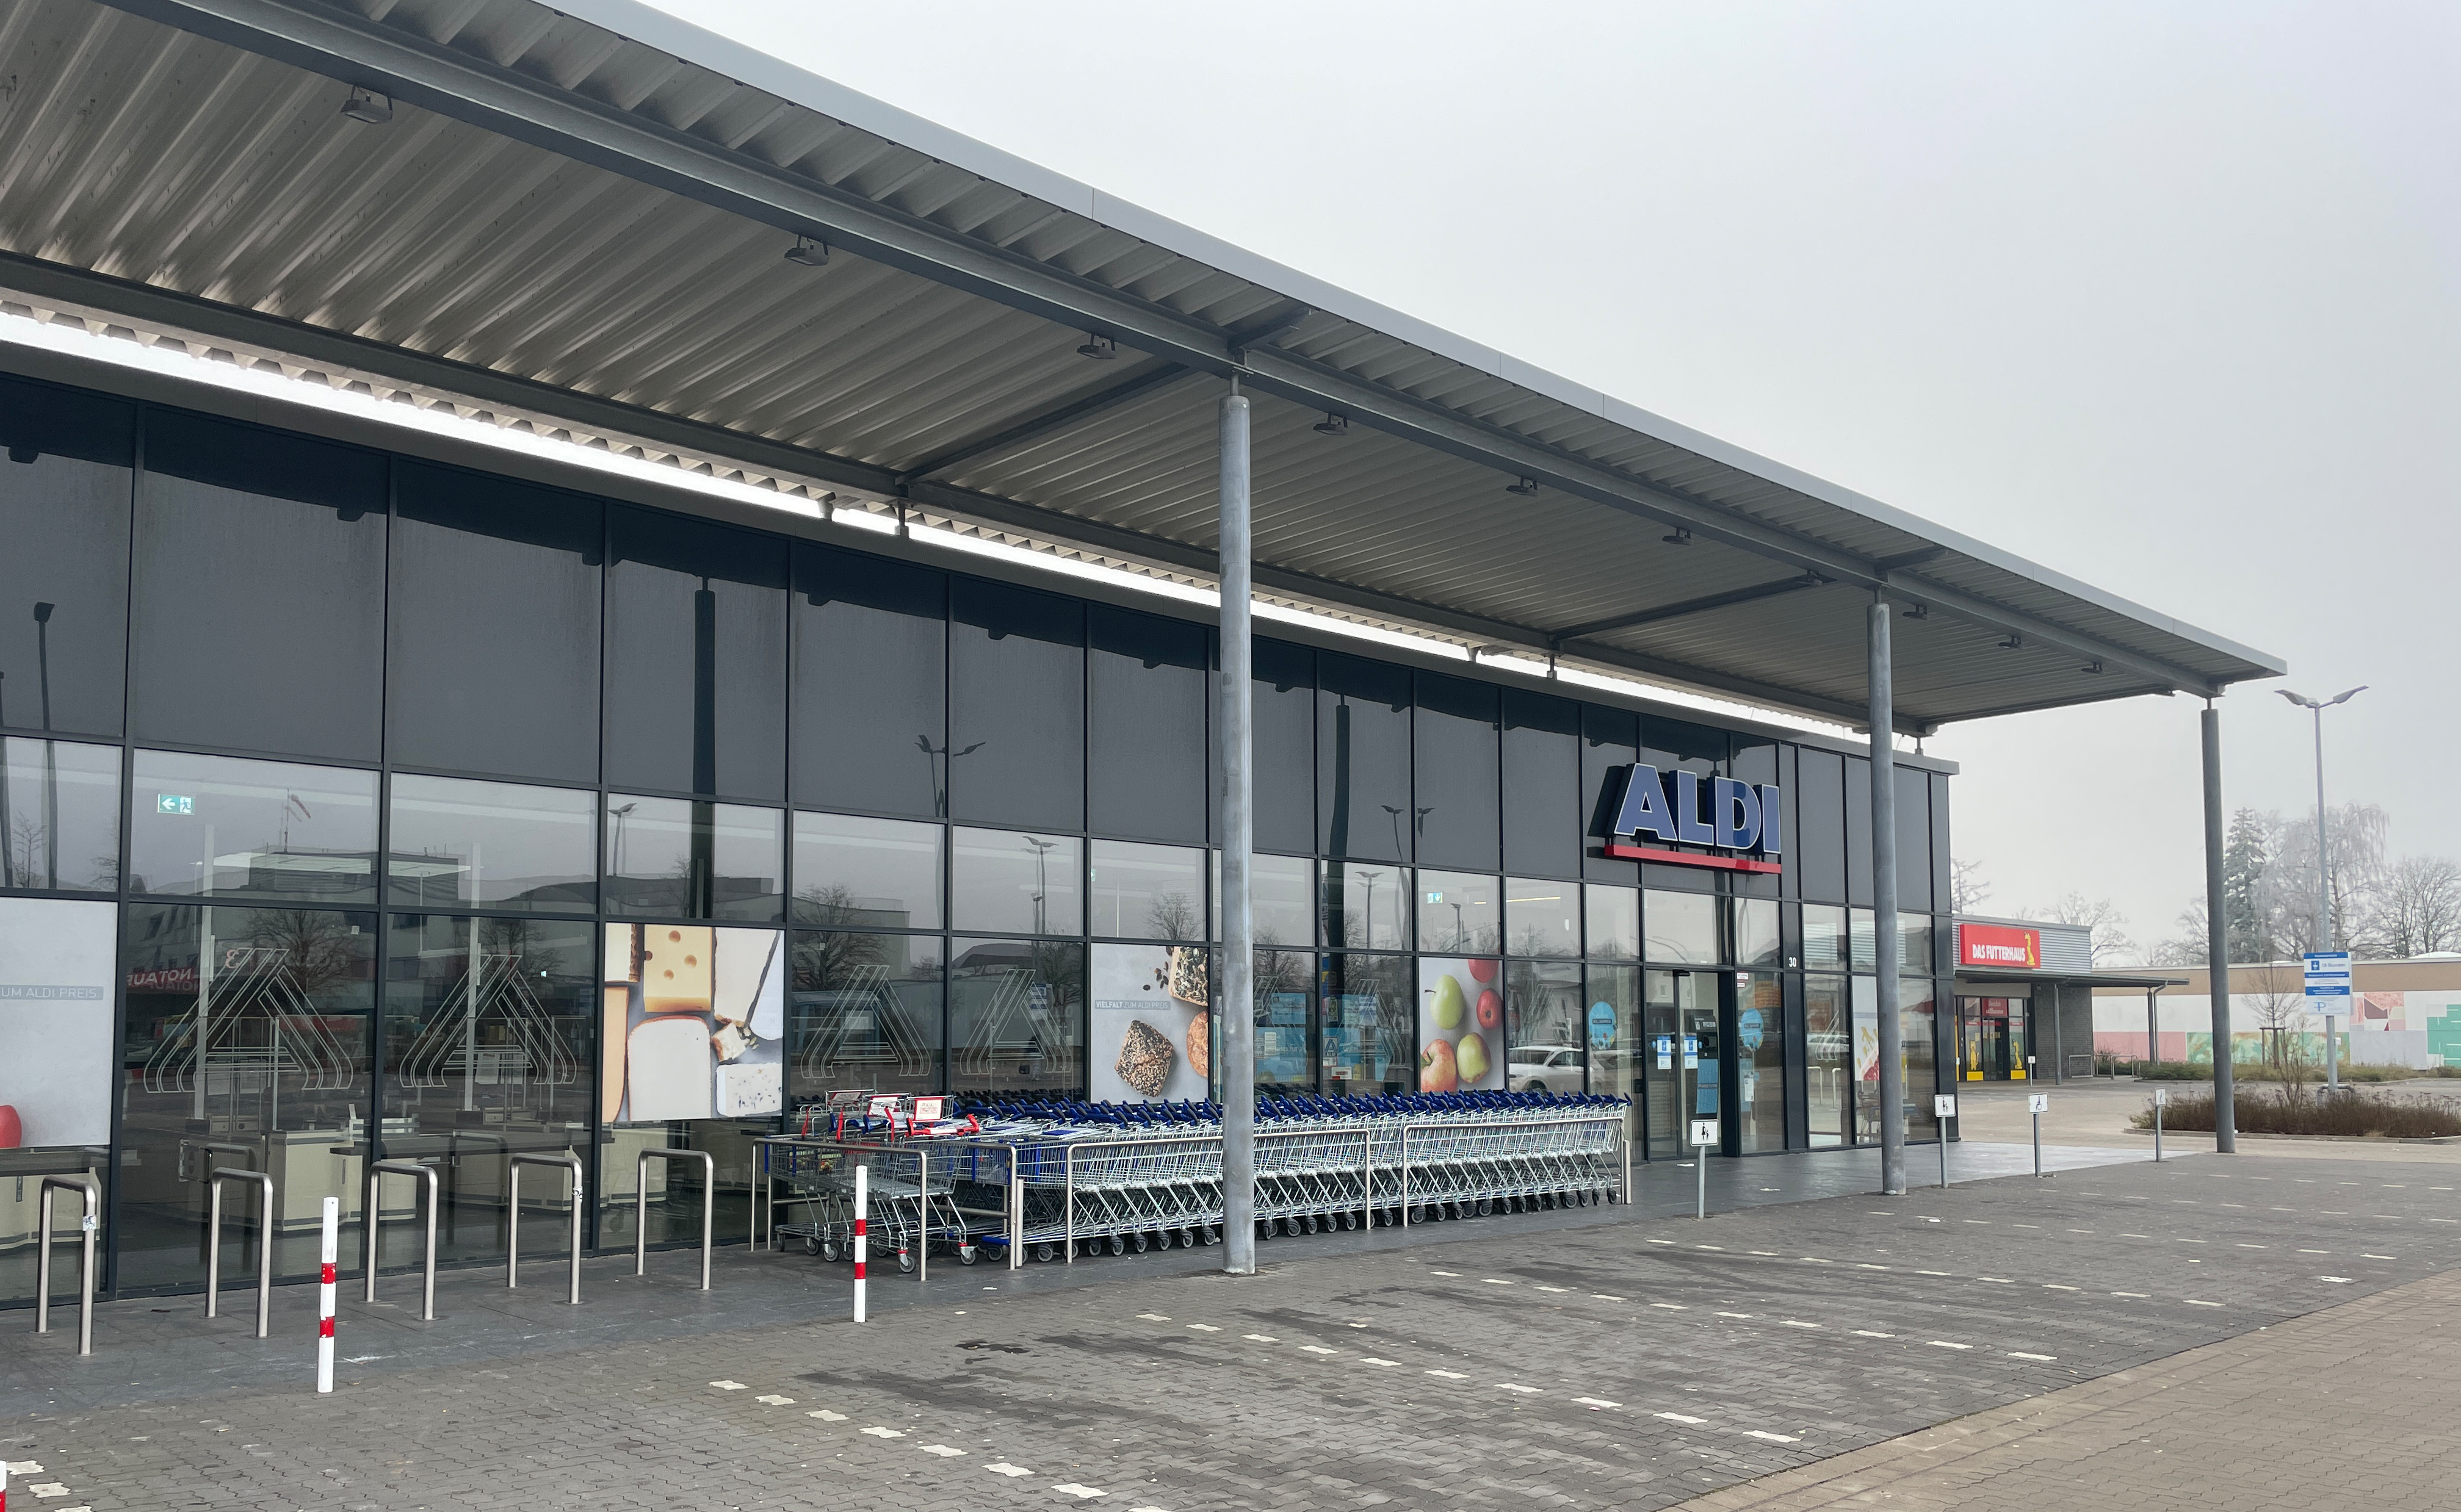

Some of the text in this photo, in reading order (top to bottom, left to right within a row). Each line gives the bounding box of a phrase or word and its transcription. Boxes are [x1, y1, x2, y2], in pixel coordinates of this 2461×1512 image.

[1612, 763, 1781, 854] ALDI
[1972, 944, 2026, 962] DAS FUTTERHAUS
[1788, 957, 1797, 968] 30
[0, 987, 100, 999] UM ALDI PREIS.
